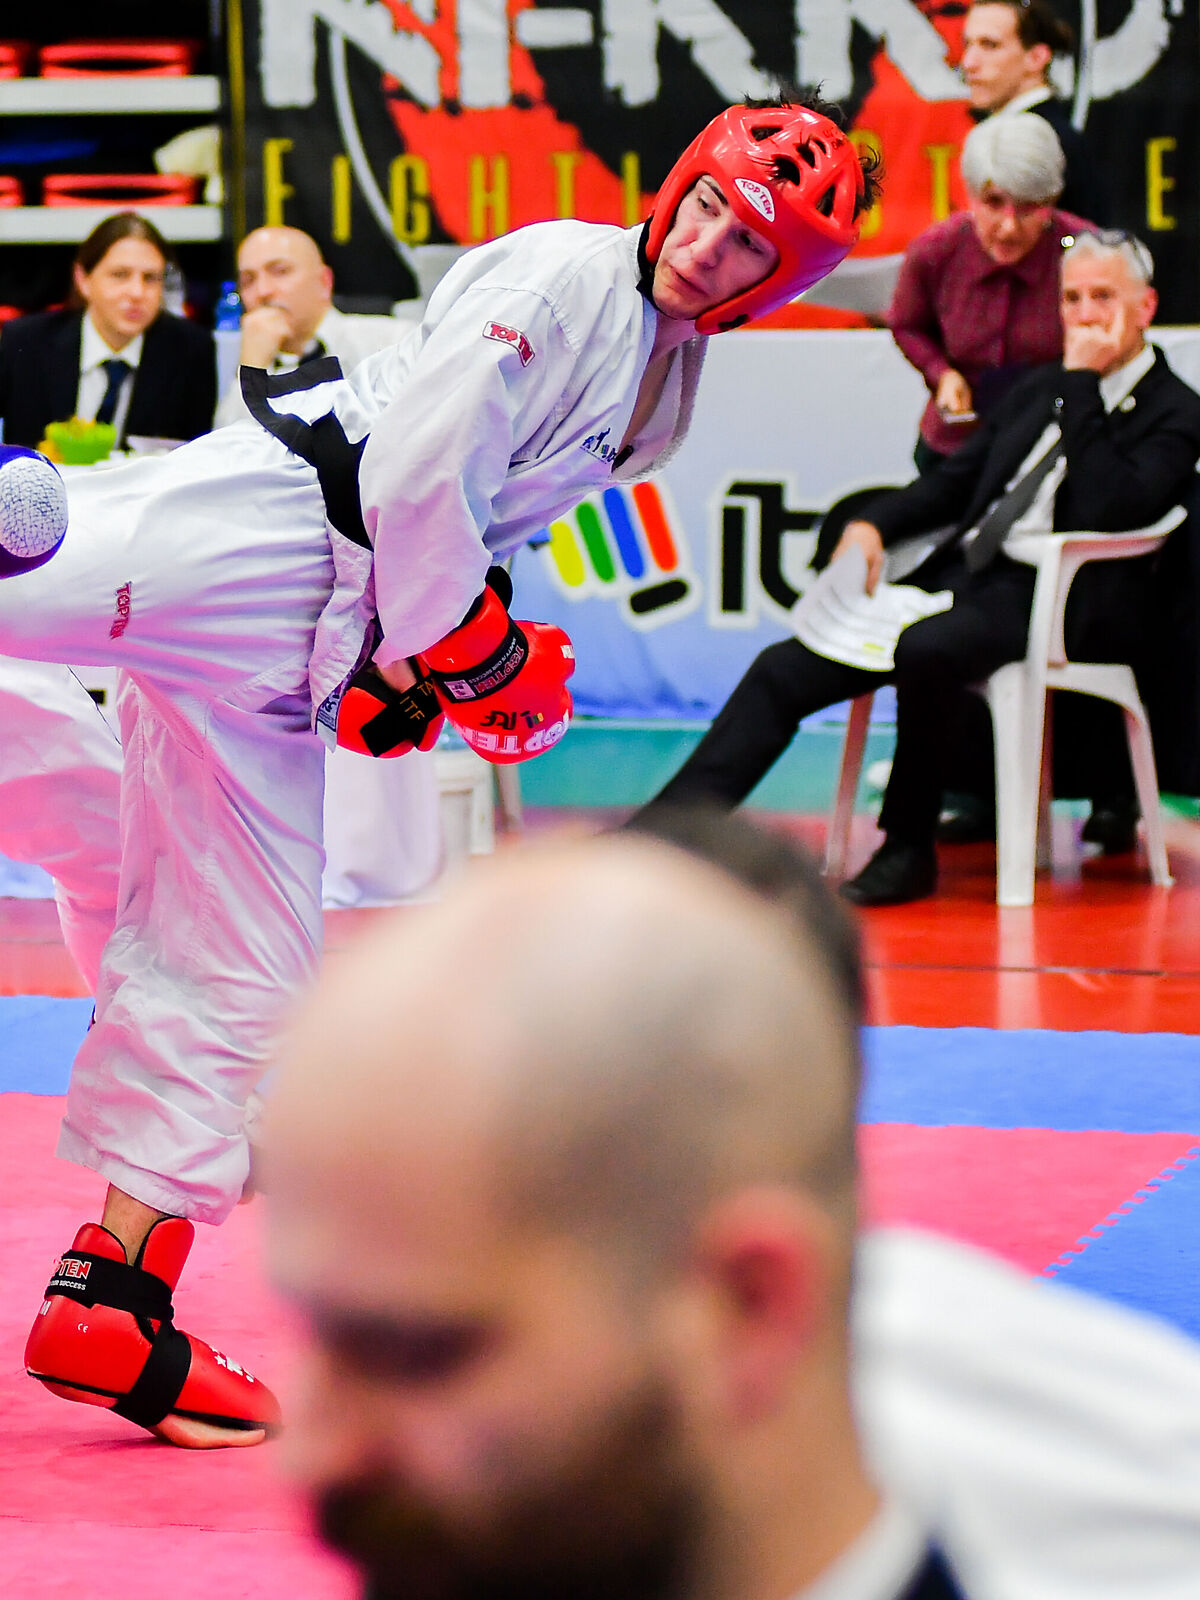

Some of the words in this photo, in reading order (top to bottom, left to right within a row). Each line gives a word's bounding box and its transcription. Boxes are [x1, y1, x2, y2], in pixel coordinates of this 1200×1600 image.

[740, 180, 760, 194] TOP
[759, 190, 773, 215] TEN
[490, 324, 518, 342] TOP
